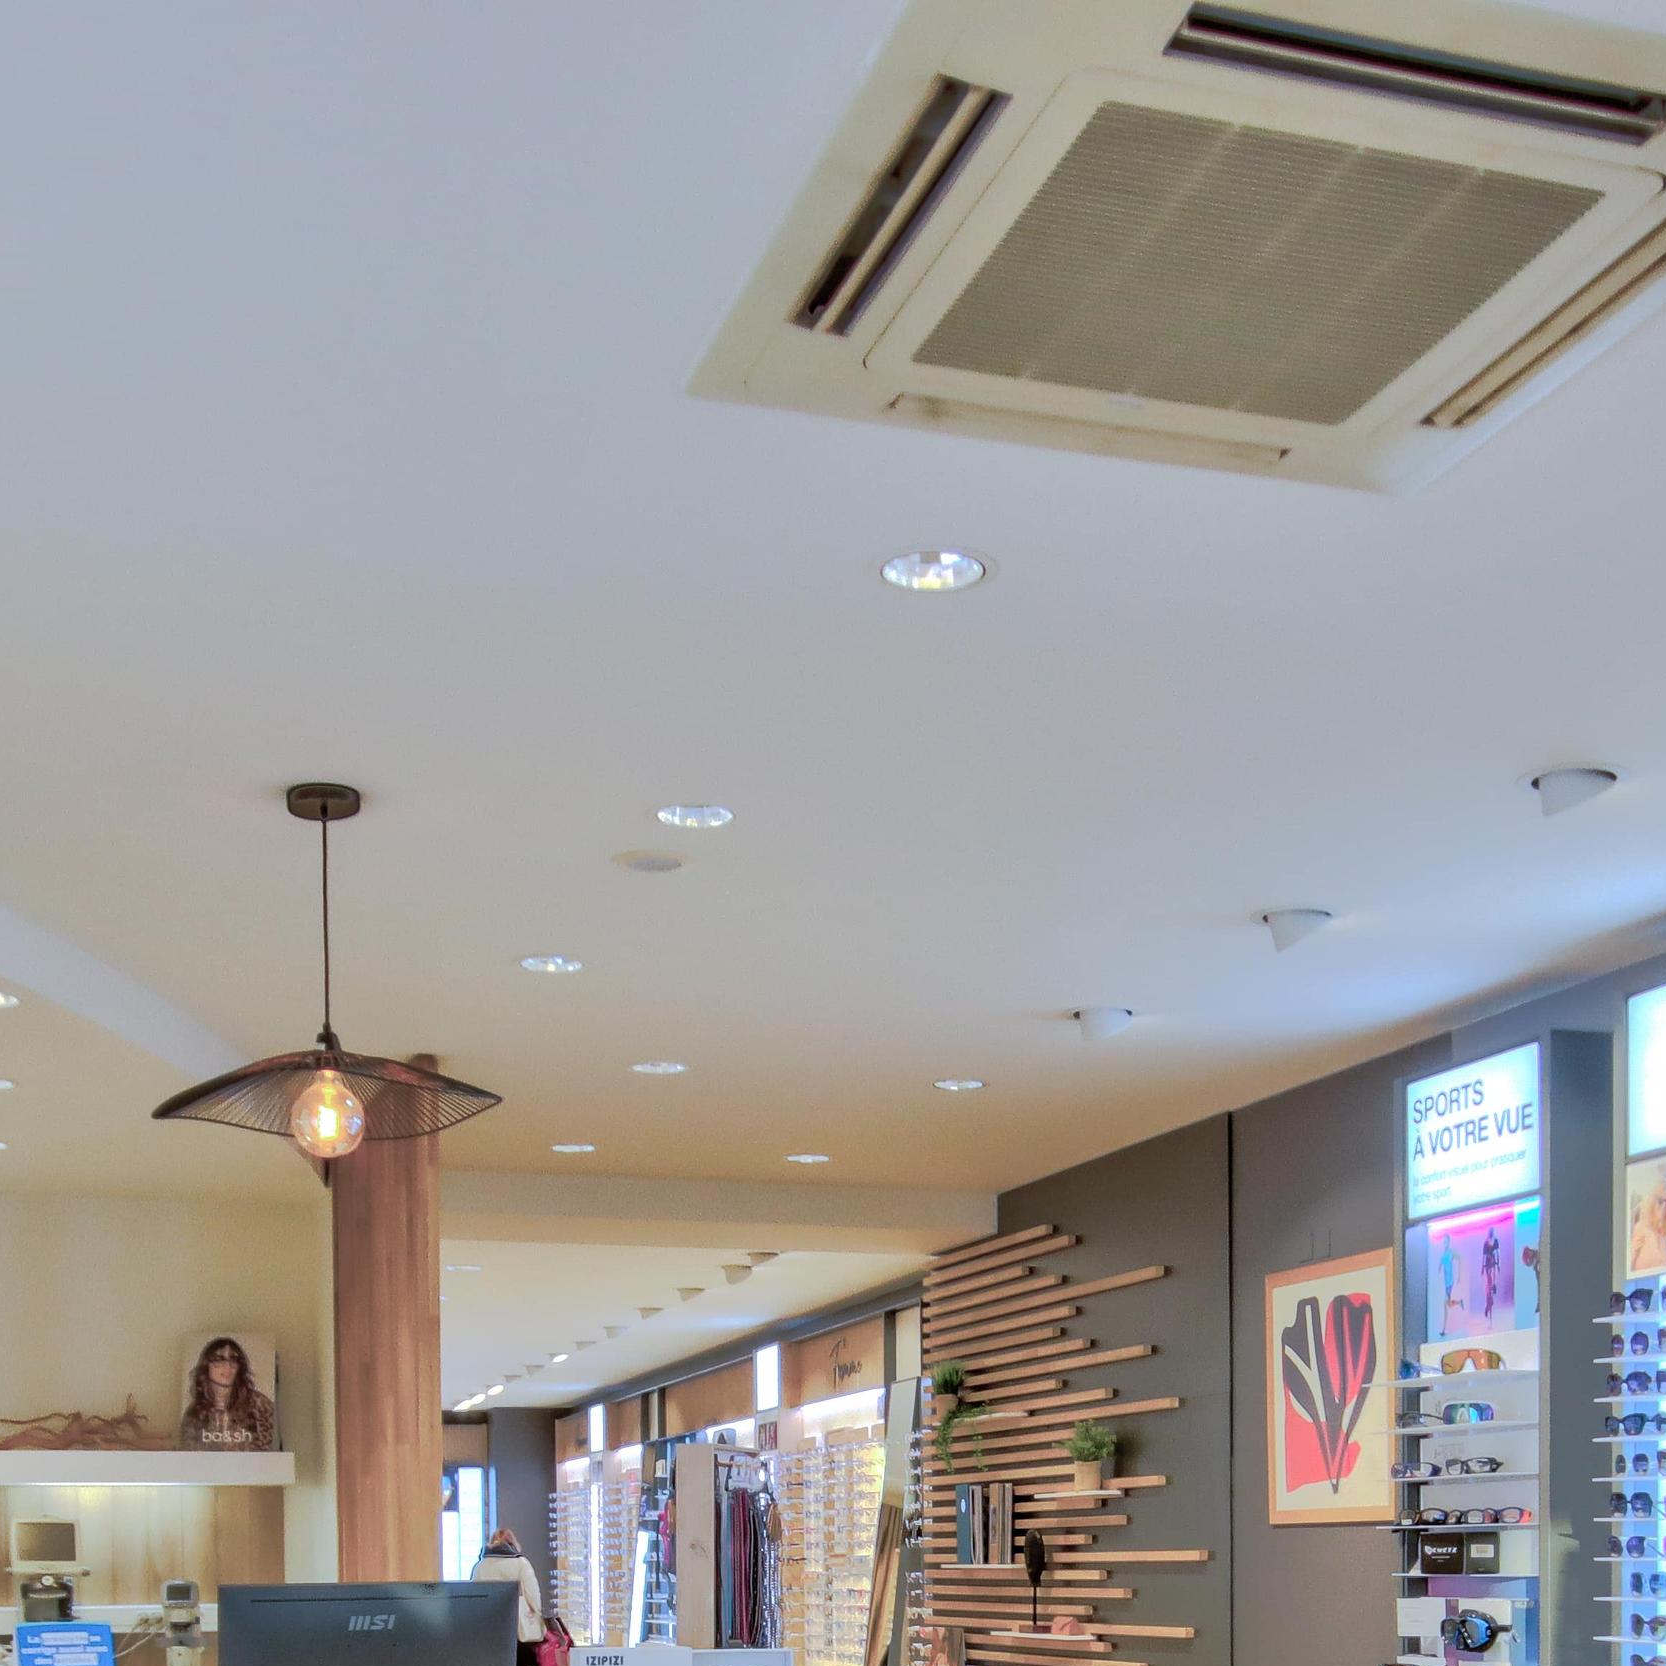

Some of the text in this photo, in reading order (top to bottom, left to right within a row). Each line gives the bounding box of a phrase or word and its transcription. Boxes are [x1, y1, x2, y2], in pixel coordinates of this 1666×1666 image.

[1413, 1079, 1484, 1124] SPORTS
[1413, 1102, 1533, 1161] À VOTRE VUE
[1471, 1159, 1489, 1172] pour
[1491, 1149, 1527, 1168] pratiquer
[1433, 1186, 1451, 1201] sport
[202, 1428, 252, 1442] ba&sh
[348, 1614, 396, 1631] MSI
[586, 1656, 624, 1666] IZIPIZI
